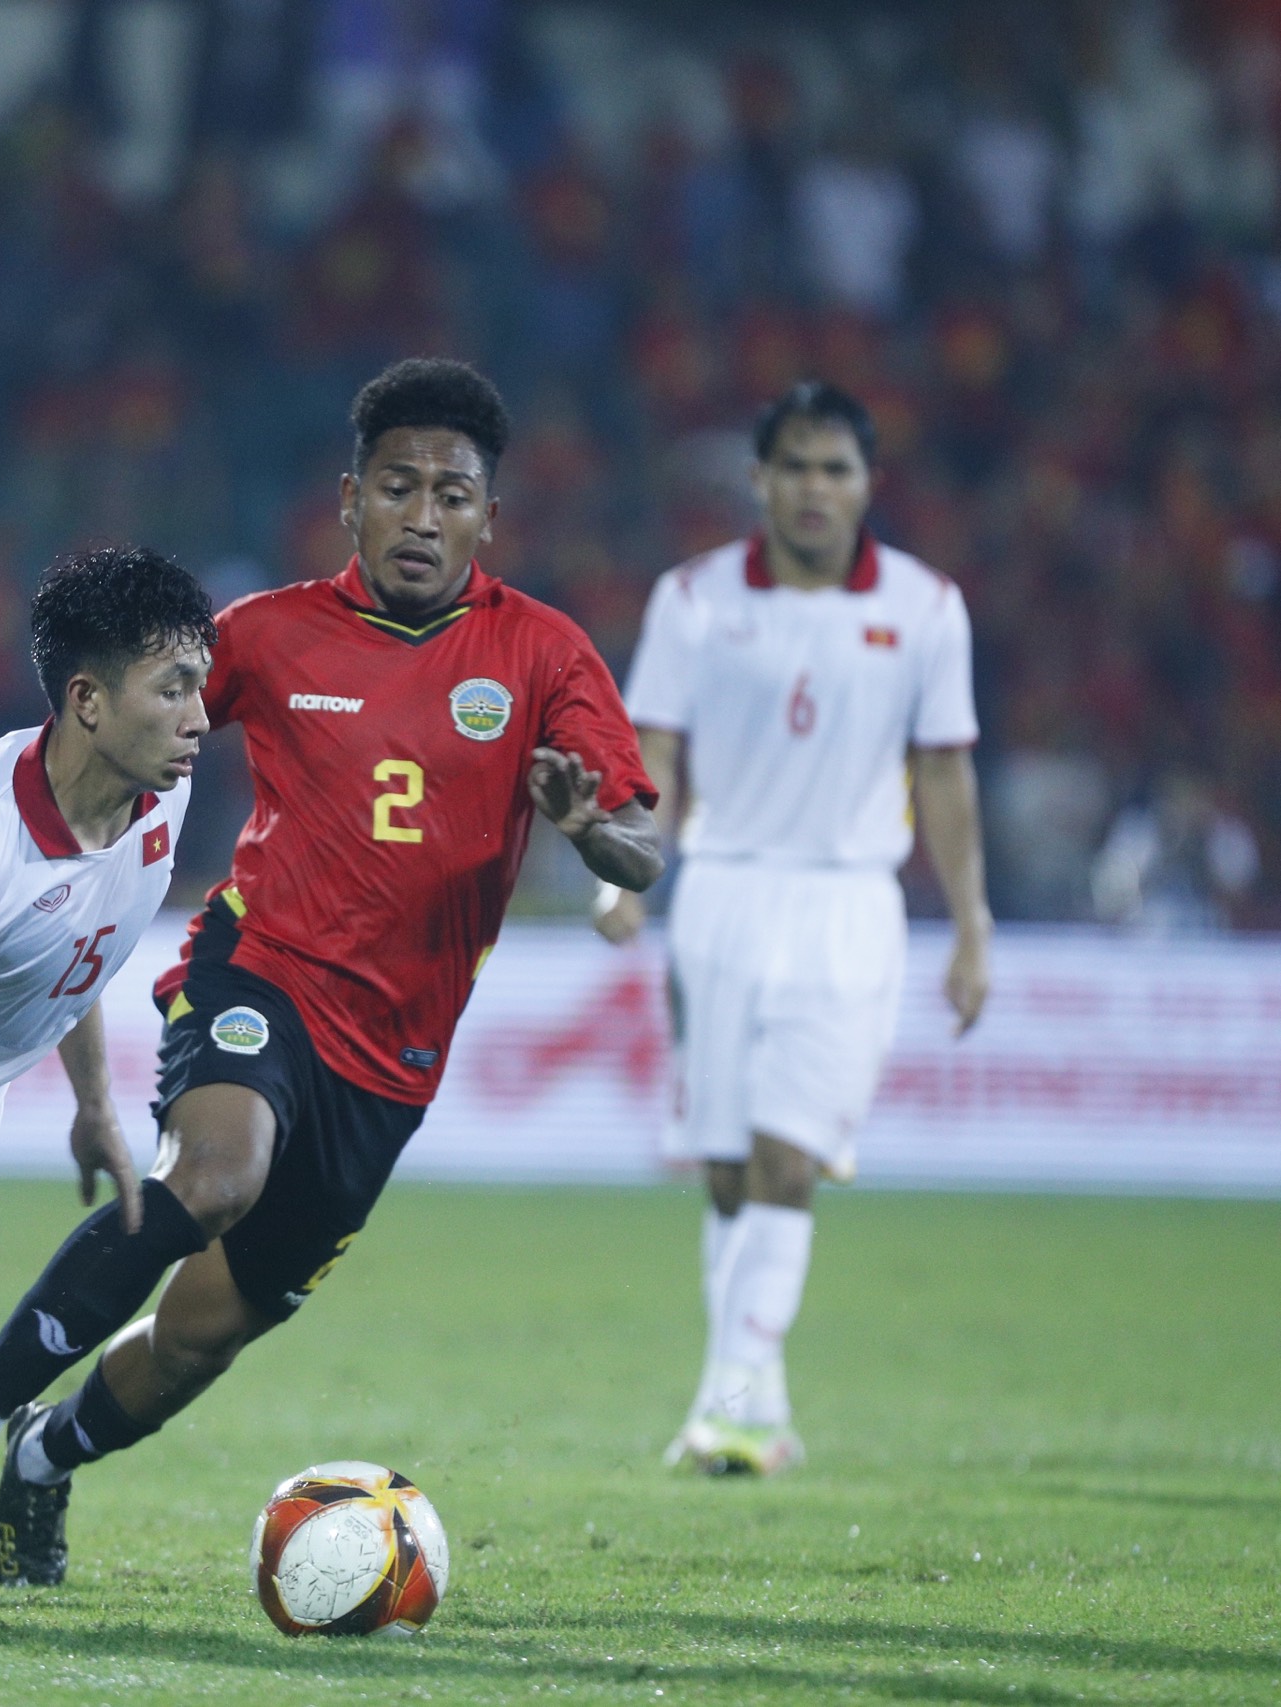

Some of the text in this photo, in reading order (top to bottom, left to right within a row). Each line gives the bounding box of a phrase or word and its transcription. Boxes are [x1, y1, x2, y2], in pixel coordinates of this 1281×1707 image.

[288, 693, 365, 713] narrow
[787, 668, 817, 740] 6
[373, 758, 424, 843] 2
[48, 924, 117, 999] 15
